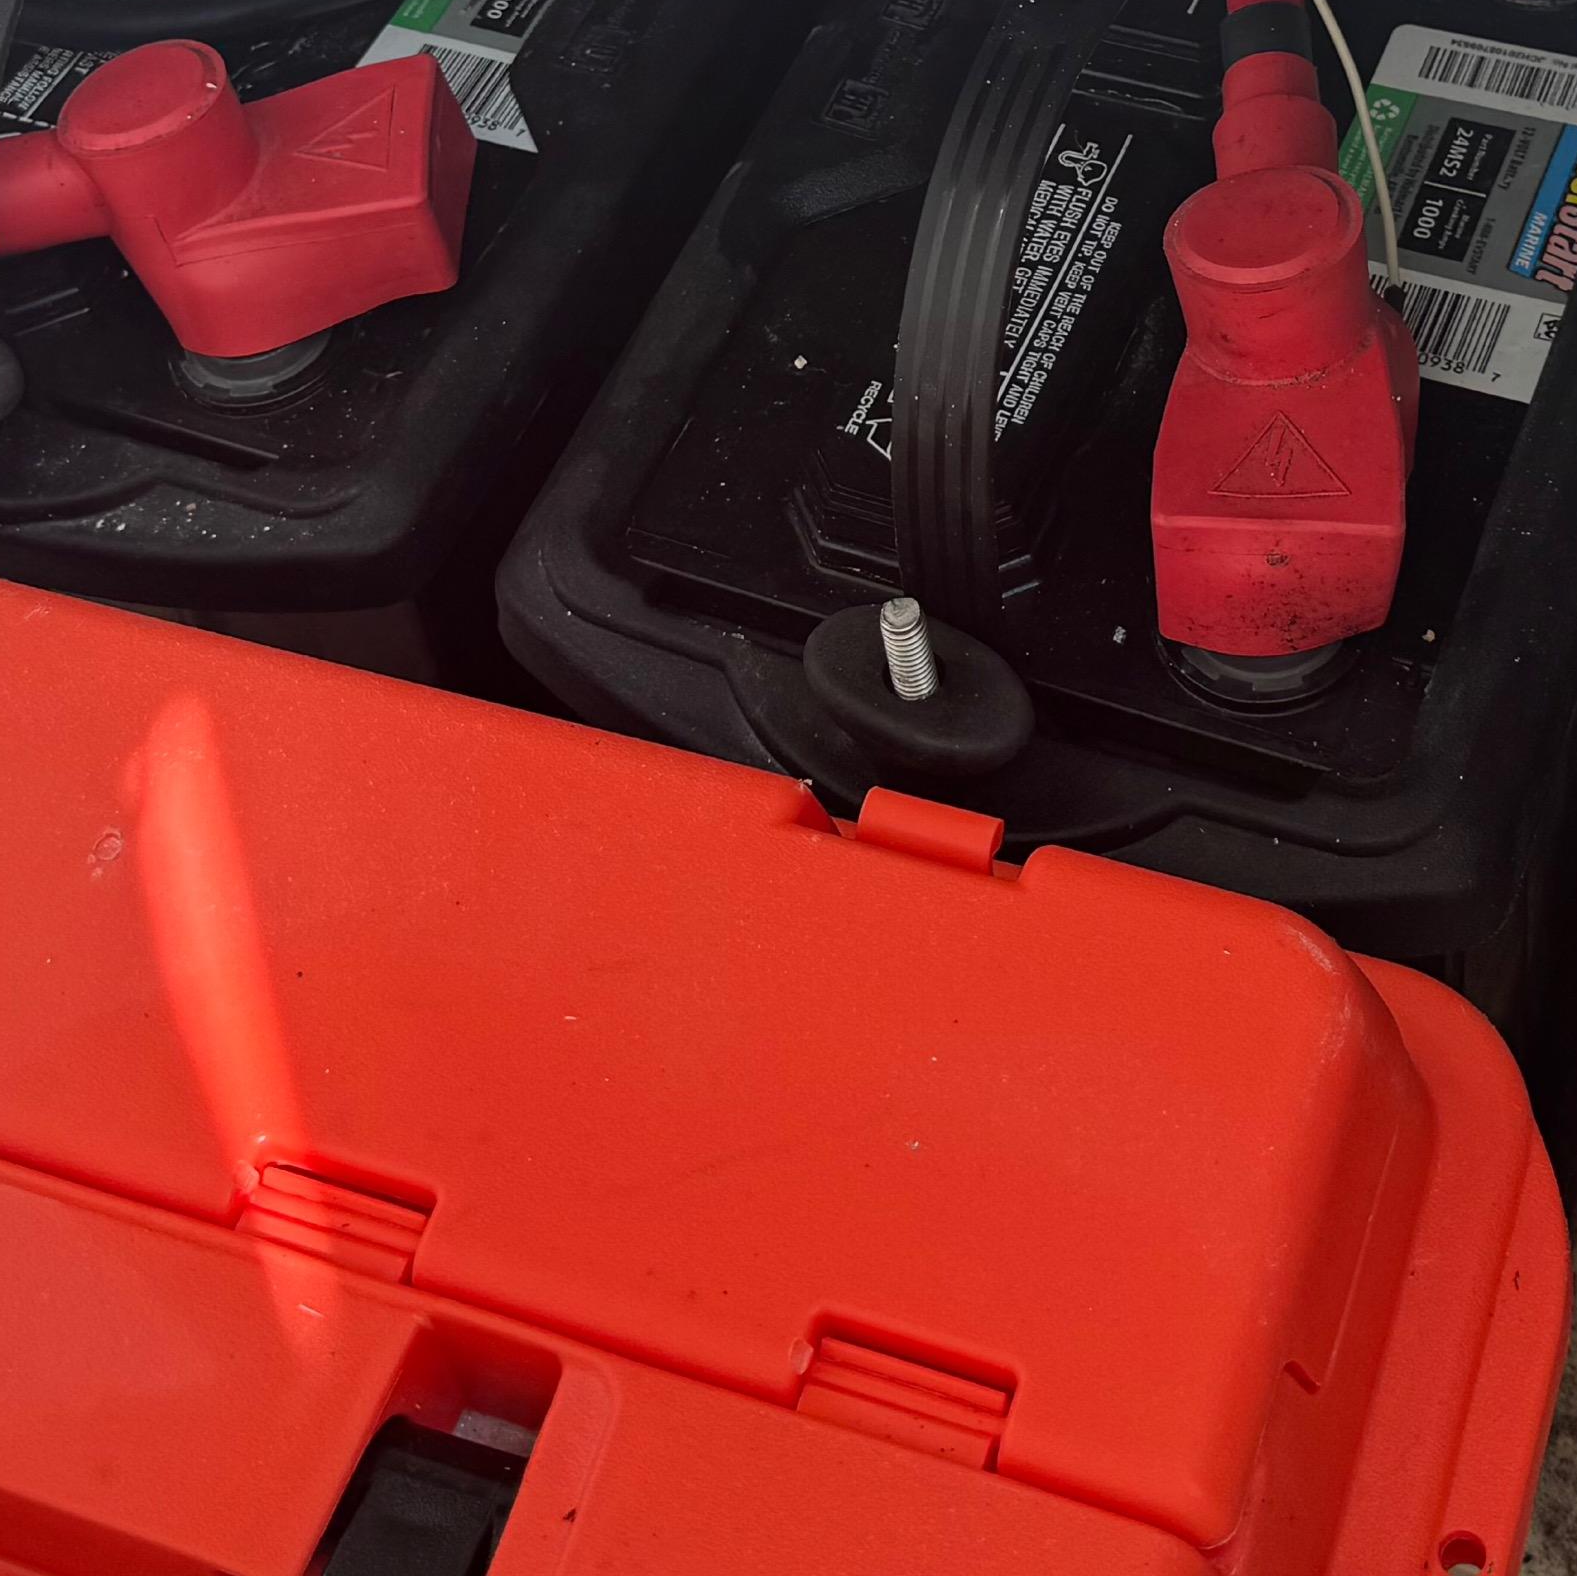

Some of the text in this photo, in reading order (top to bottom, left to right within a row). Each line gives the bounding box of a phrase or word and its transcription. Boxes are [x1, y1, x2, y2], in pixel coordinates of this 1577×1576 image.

[1438, 127, 1474, 176] 24MS2
[1043, 183, 1073, 215] WITH
[1099, 196, 1118, 212] DO
[1087, 214, 1109, 235] NOT
[1412, 199, 1444, 238] 1000
[1019, 217, 1056, 263] WATER.
[1515, 211, 1546, 269] MARINE
[997, 187, 1093, 348] FLUSH EYES IMMEDIATELY
[1061, 261, 1086, 288] KEEP
[1046, 290, 1071, 318] VENT
[1009, 221, 1122, 424] KEEP OUT OF THE REACH OF CHILDREN
[1031, 319, 1056, 347] CAPS
[1014, 350, 1041, 382] TIGHT
[1490, 371, 1501, 383] 7
[843, 380, 882, 435] RECYCLE
[1000, 384, 1023, 407] AND
